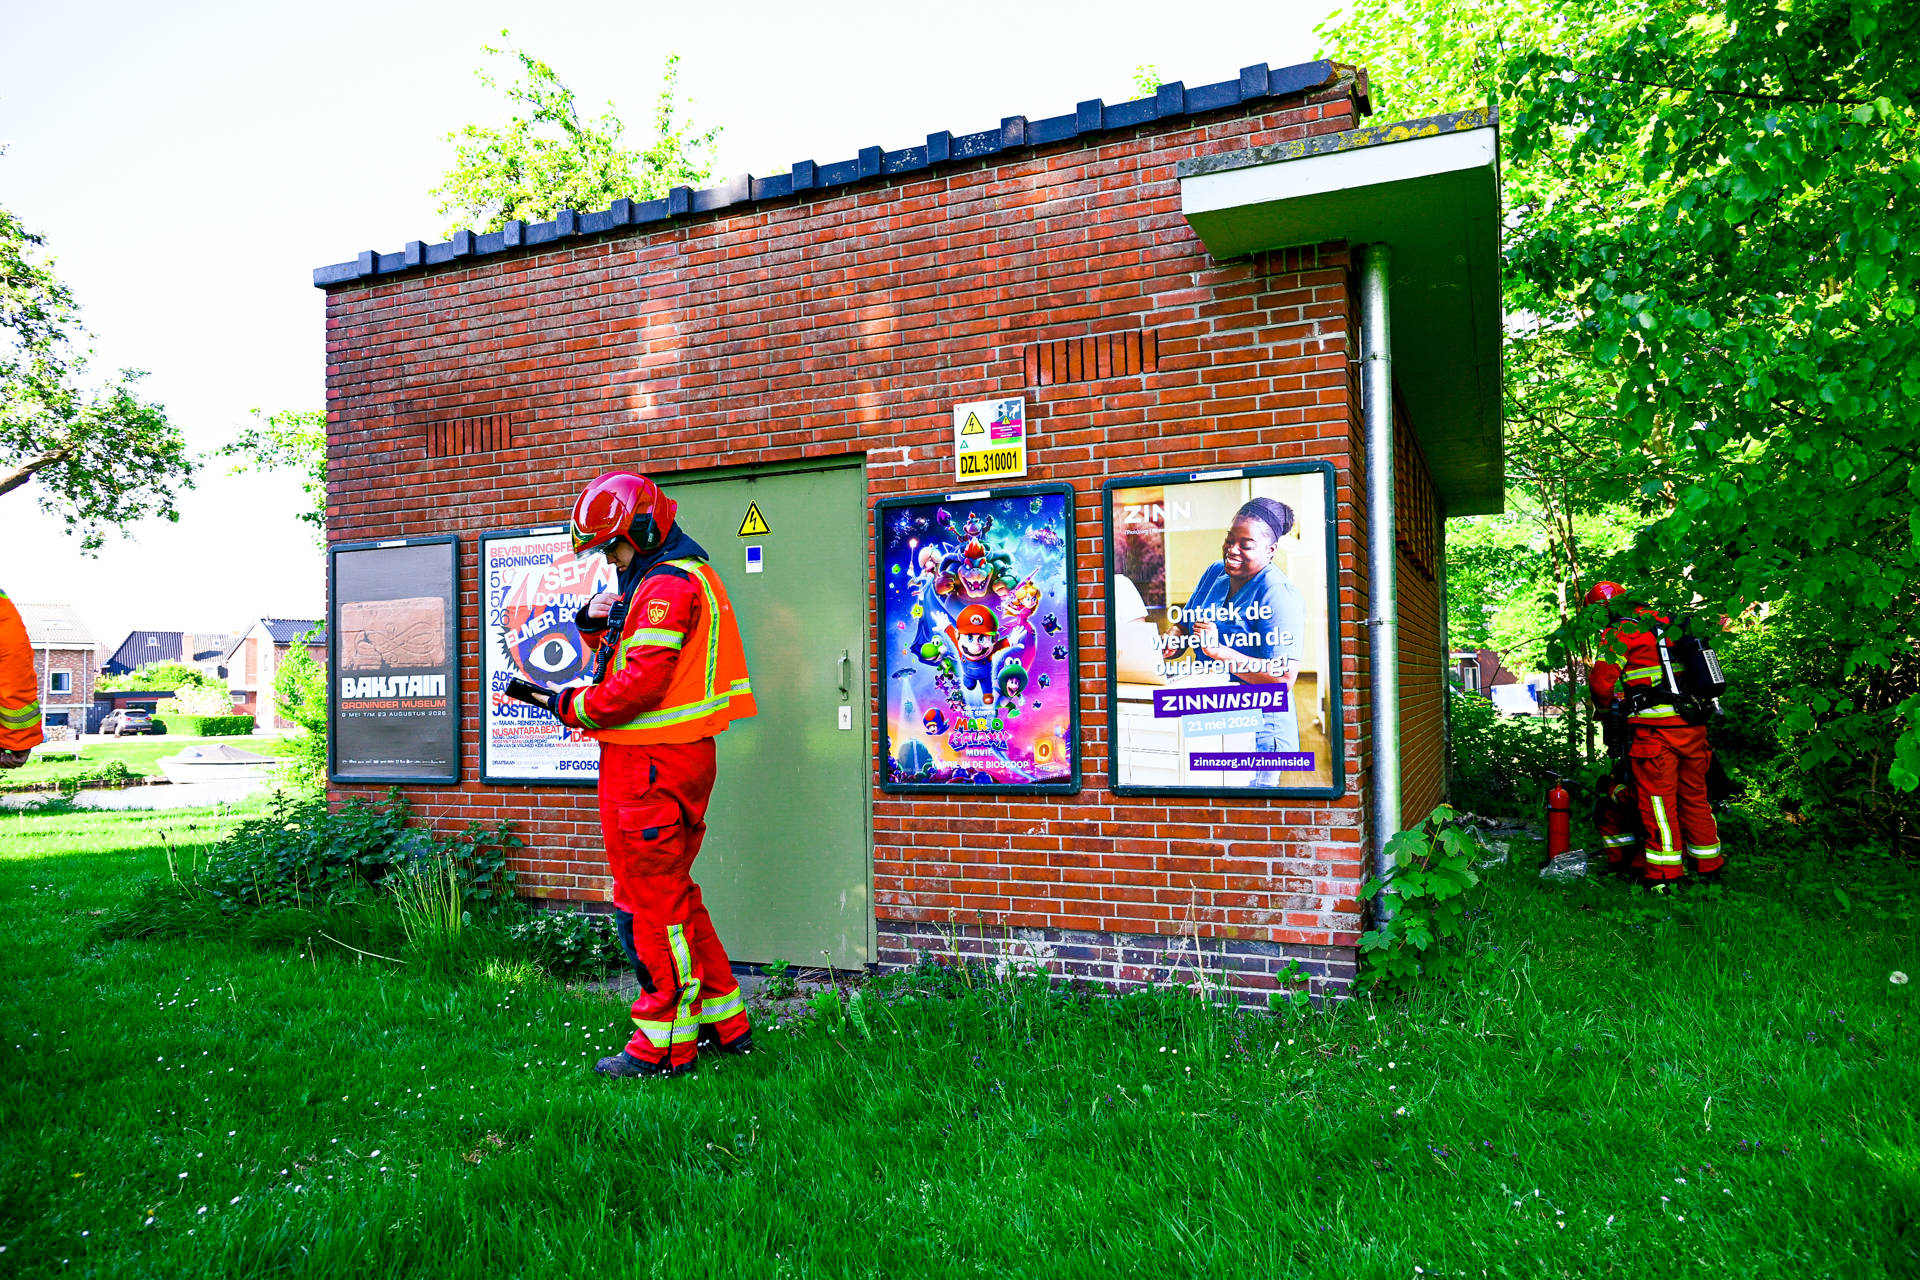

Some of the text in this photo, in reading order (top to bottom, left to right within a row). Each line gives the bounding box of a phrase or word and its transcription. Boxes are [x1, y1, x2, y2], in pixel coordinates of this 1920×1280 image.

[961, 451, 1017, 474] DZL.310001
[1123, 501, 1191, 524] ZINN
[490, 541, 573, 557] BEVRIJDINGSFE
[490, 554, 553, 568] GRONINGEN
[490, 571, 500, 588] 5
[490, 591, 500, 608] 5
[490, 609, 510, 626] 26
[1167, 601, 1273, 624] Ontdek de
[504, 611, 556, 649] ELMER
[1152, 627, 1294, 650] wereld van de
[1154, 654, 1290, 677] ouderenzorg!
[341, 699, 446, 710] GRONINGER MUSEUM
[1161, 691, 1284, 711] ZINNINSIDE
[492, 726, 540, 737] NUSANTARA
[540, 725, 561, 734] BEAT
[1187, 716, 1258, 732] 21 mei 2026
[559, 760, 599, 770] BFG050
[986, 760, 1029, 769] BIOSCOOP
[1193, 757, 1311, 768] zinnzorg.nl/zinninside
